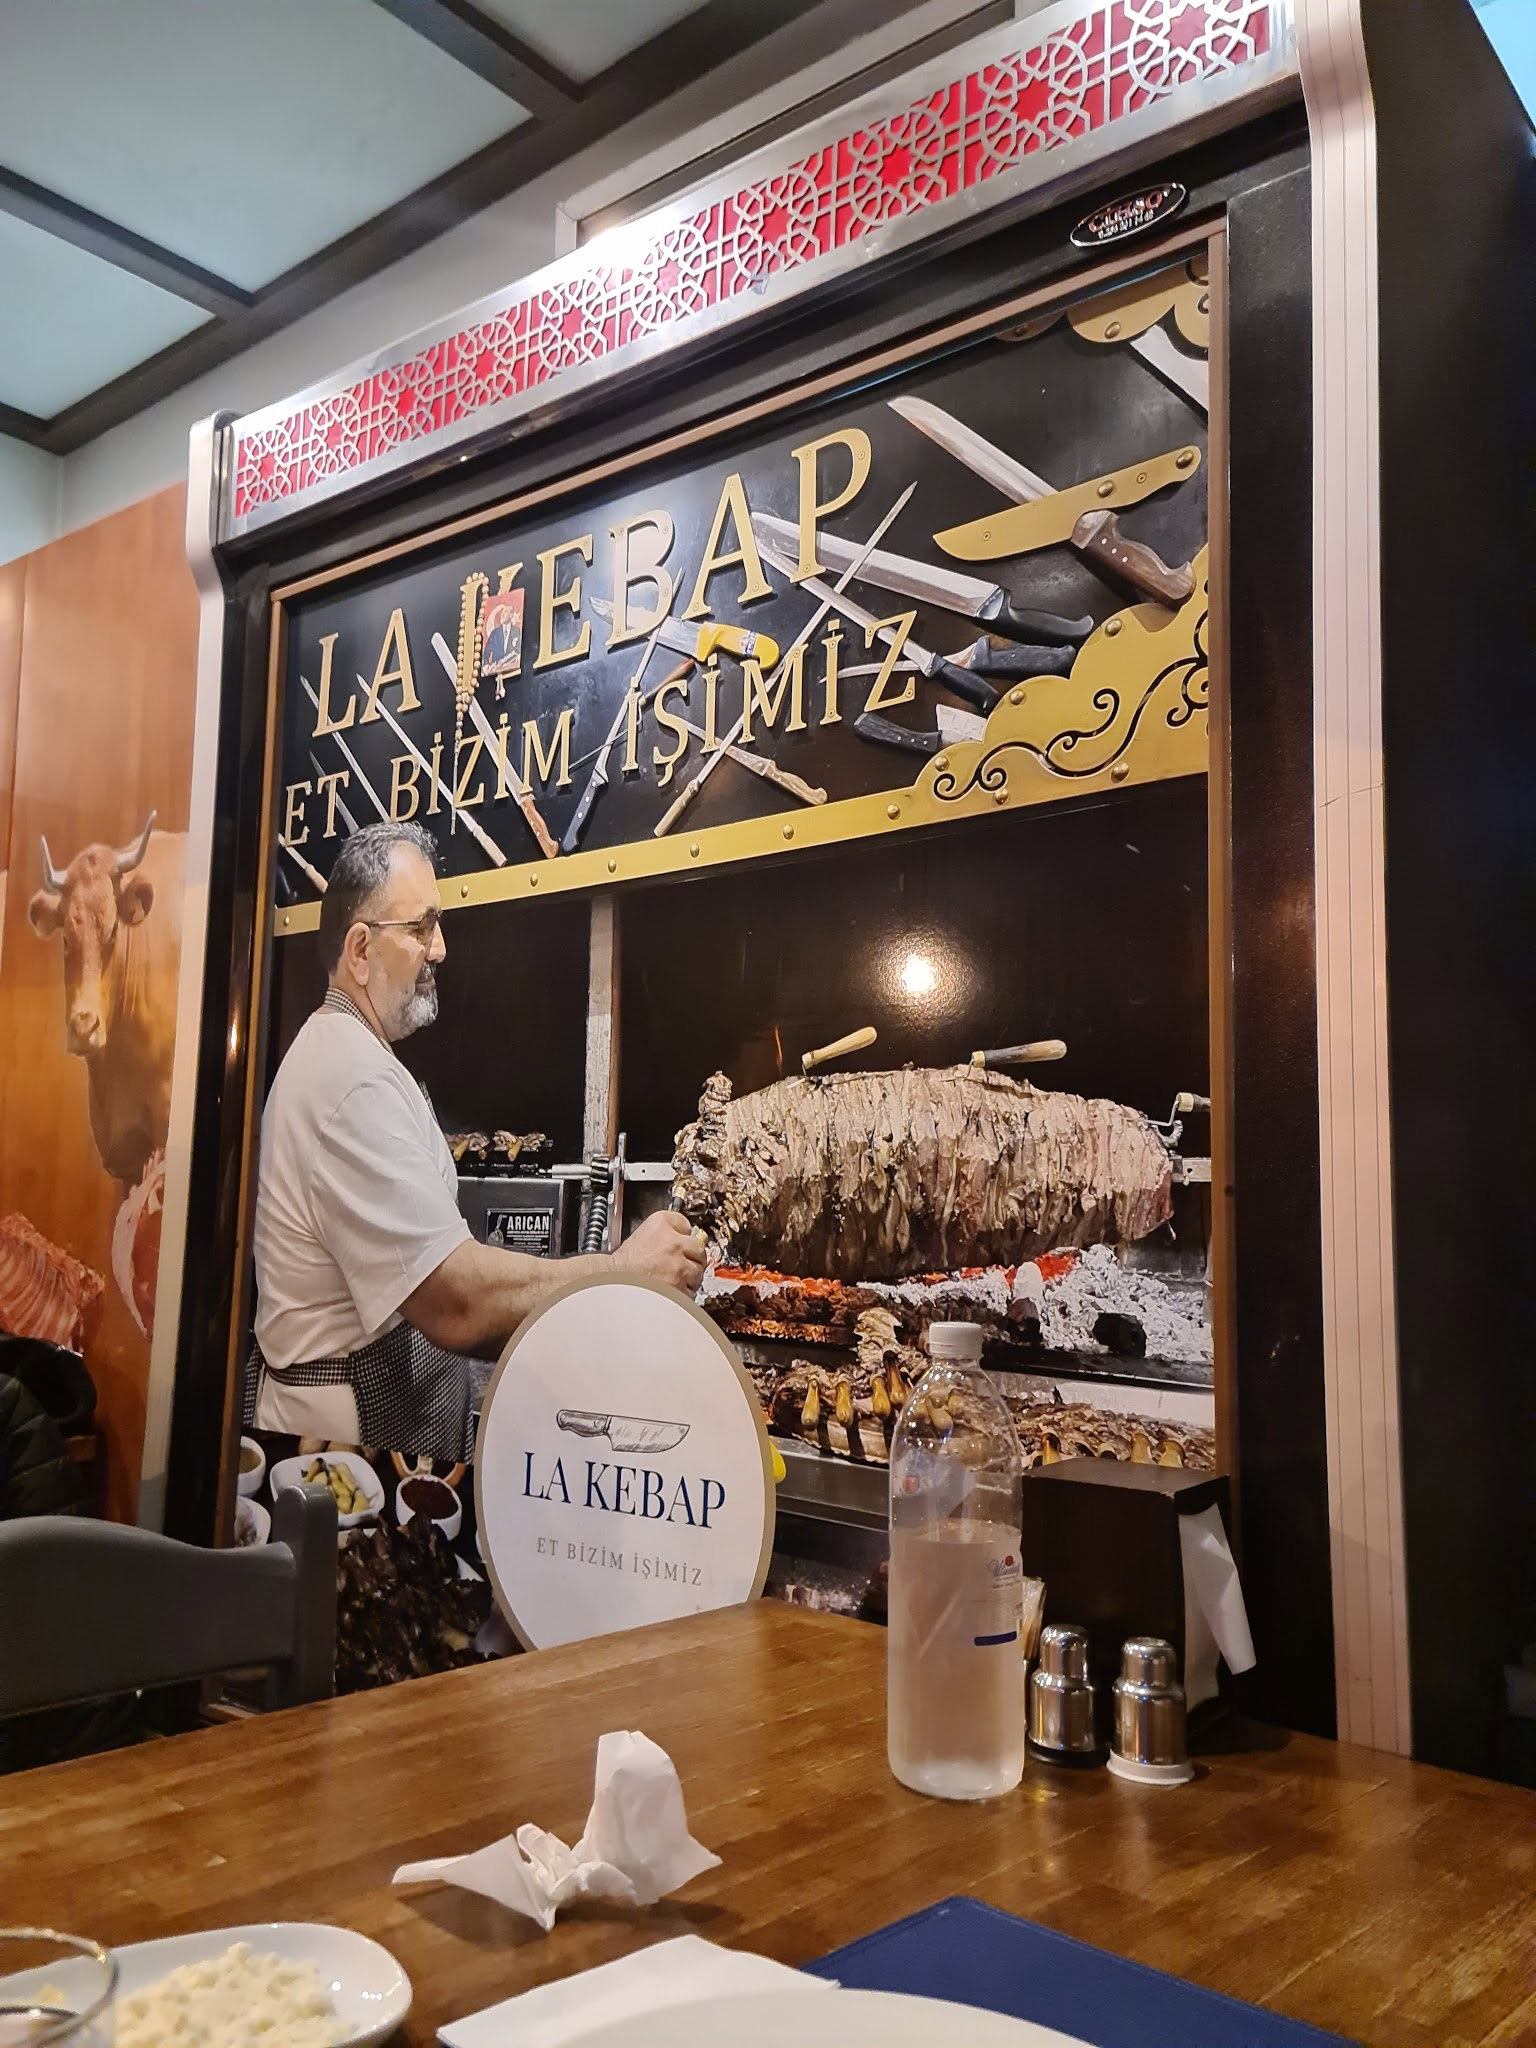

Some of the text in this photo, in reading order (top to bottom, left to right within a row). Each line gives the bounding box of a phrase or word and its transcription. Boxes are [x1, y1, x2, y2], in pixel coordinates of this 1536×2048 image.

[312, 427, 873, 737] LA KEBAP
[284, 609, 918, 847] ET BİZİM İŞİMİZ
[507, 1216, 549, 1231] ARICAN
[521, 1452, 726, 1529] LA KEBAP
[537, 1536, 703, 1587] ET BİZİM İŞİMİZ
